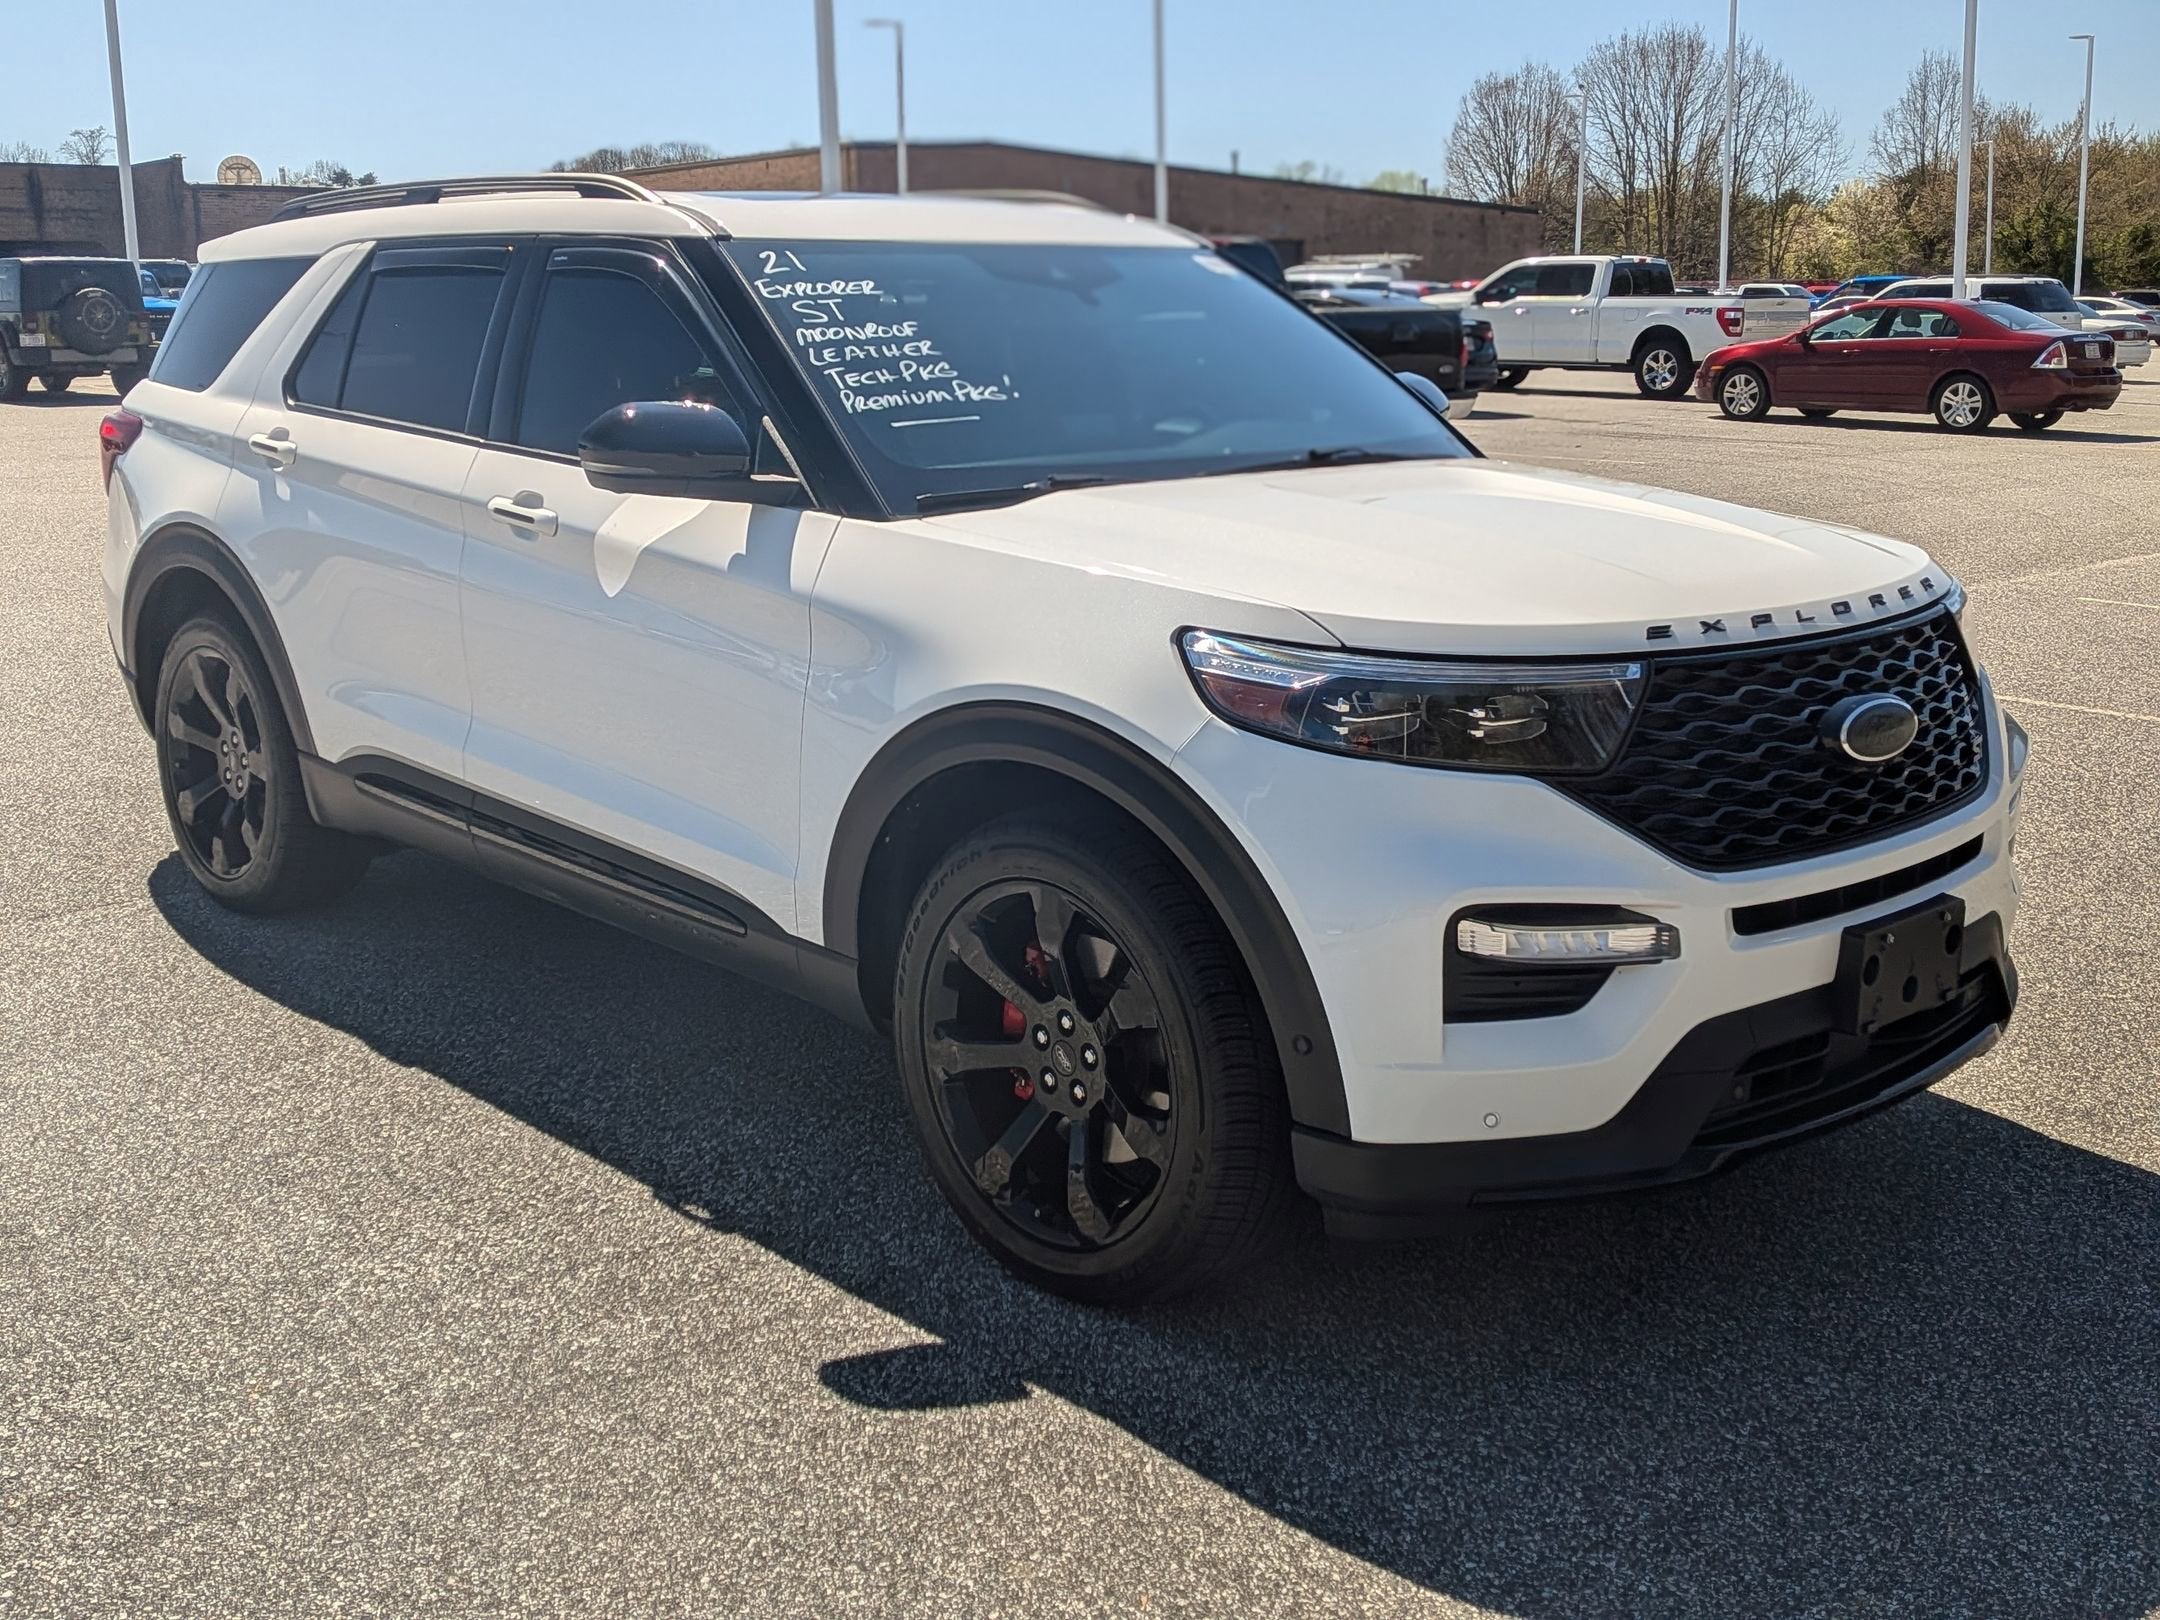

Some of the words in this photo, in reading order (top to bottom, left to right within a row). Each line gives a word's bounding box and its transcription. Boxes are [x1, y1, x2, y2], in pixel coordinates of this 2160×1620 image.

[759, 250, 807, 274] 21
[791, 298, 844, 323] ST
[1685, 307, 1713, 315] FX4
[808, 340, 942, 366] LEATHER
[1645, 575, 1935, 641] EXPLORER
